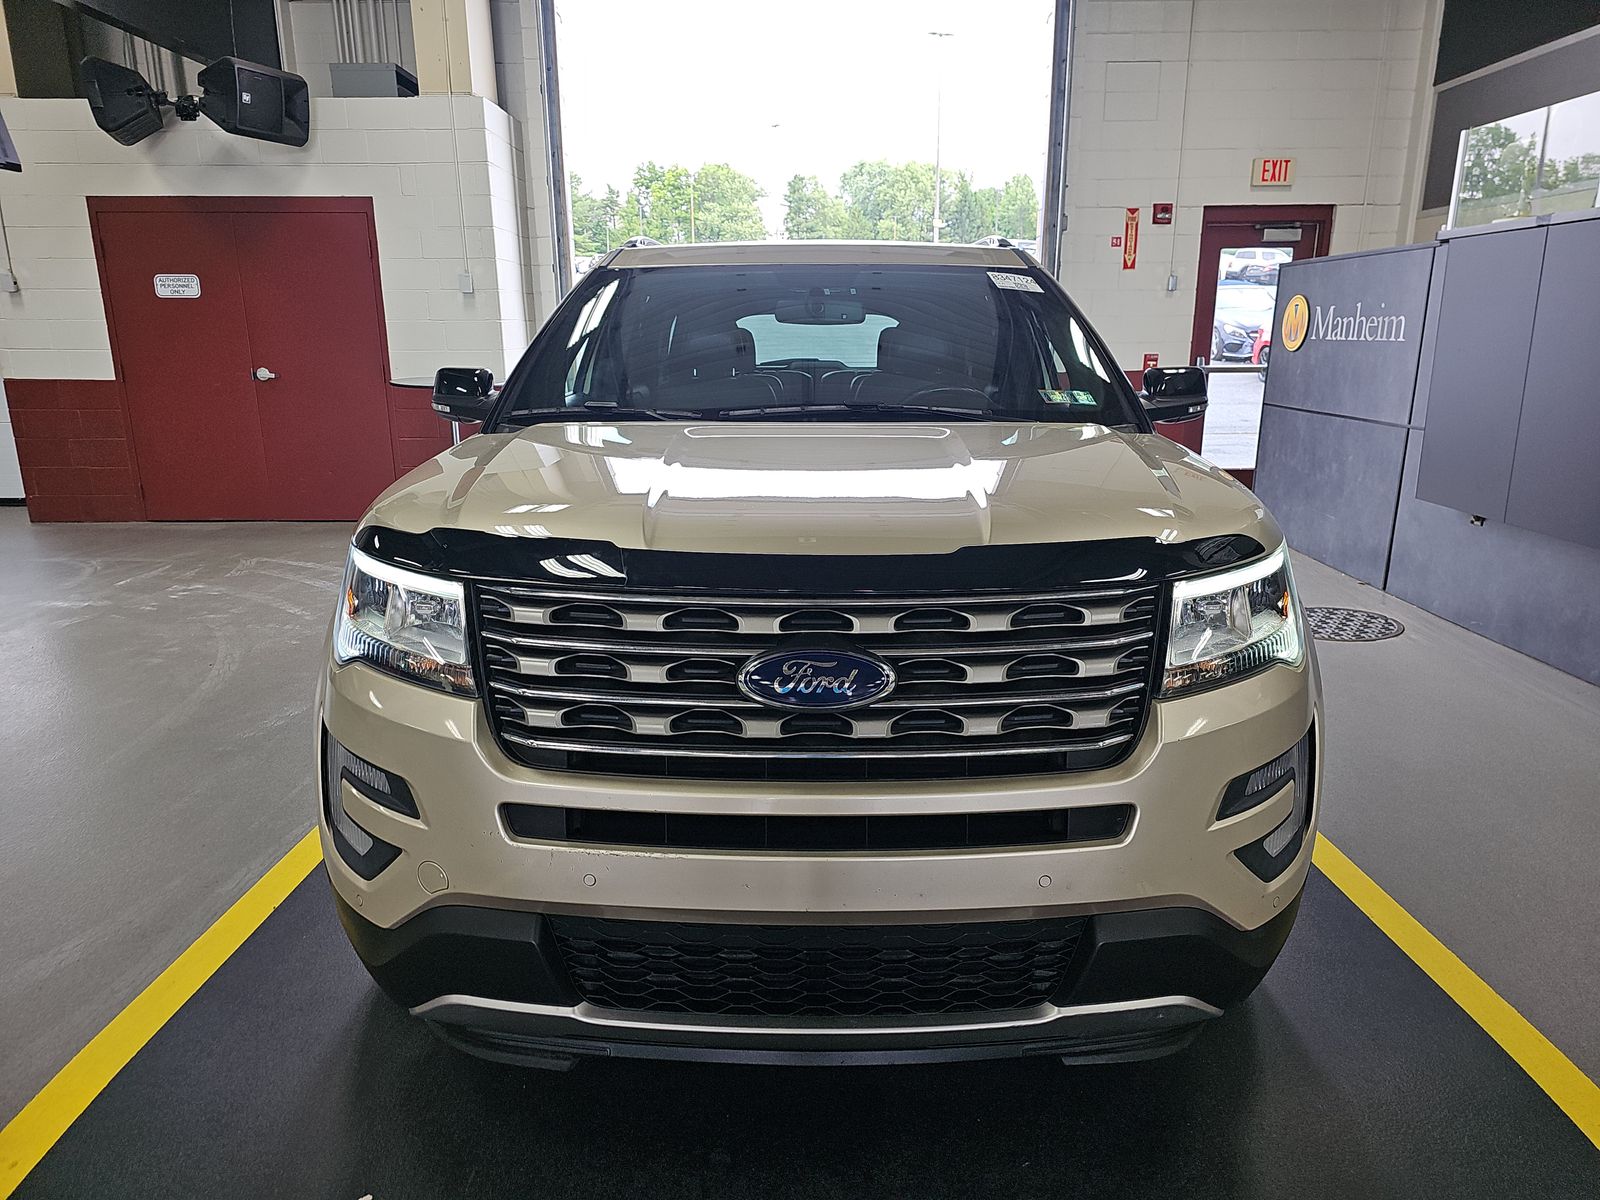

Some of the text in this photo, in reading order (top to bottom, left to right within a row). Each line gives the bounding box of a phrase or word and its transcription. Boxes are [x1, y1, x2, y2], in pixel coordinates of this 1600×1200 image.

[1261, 159, 1291, 182] EXIT
[1310, 302, 1406, 342] Manheim
[773, 659, 859, 696] Ford
